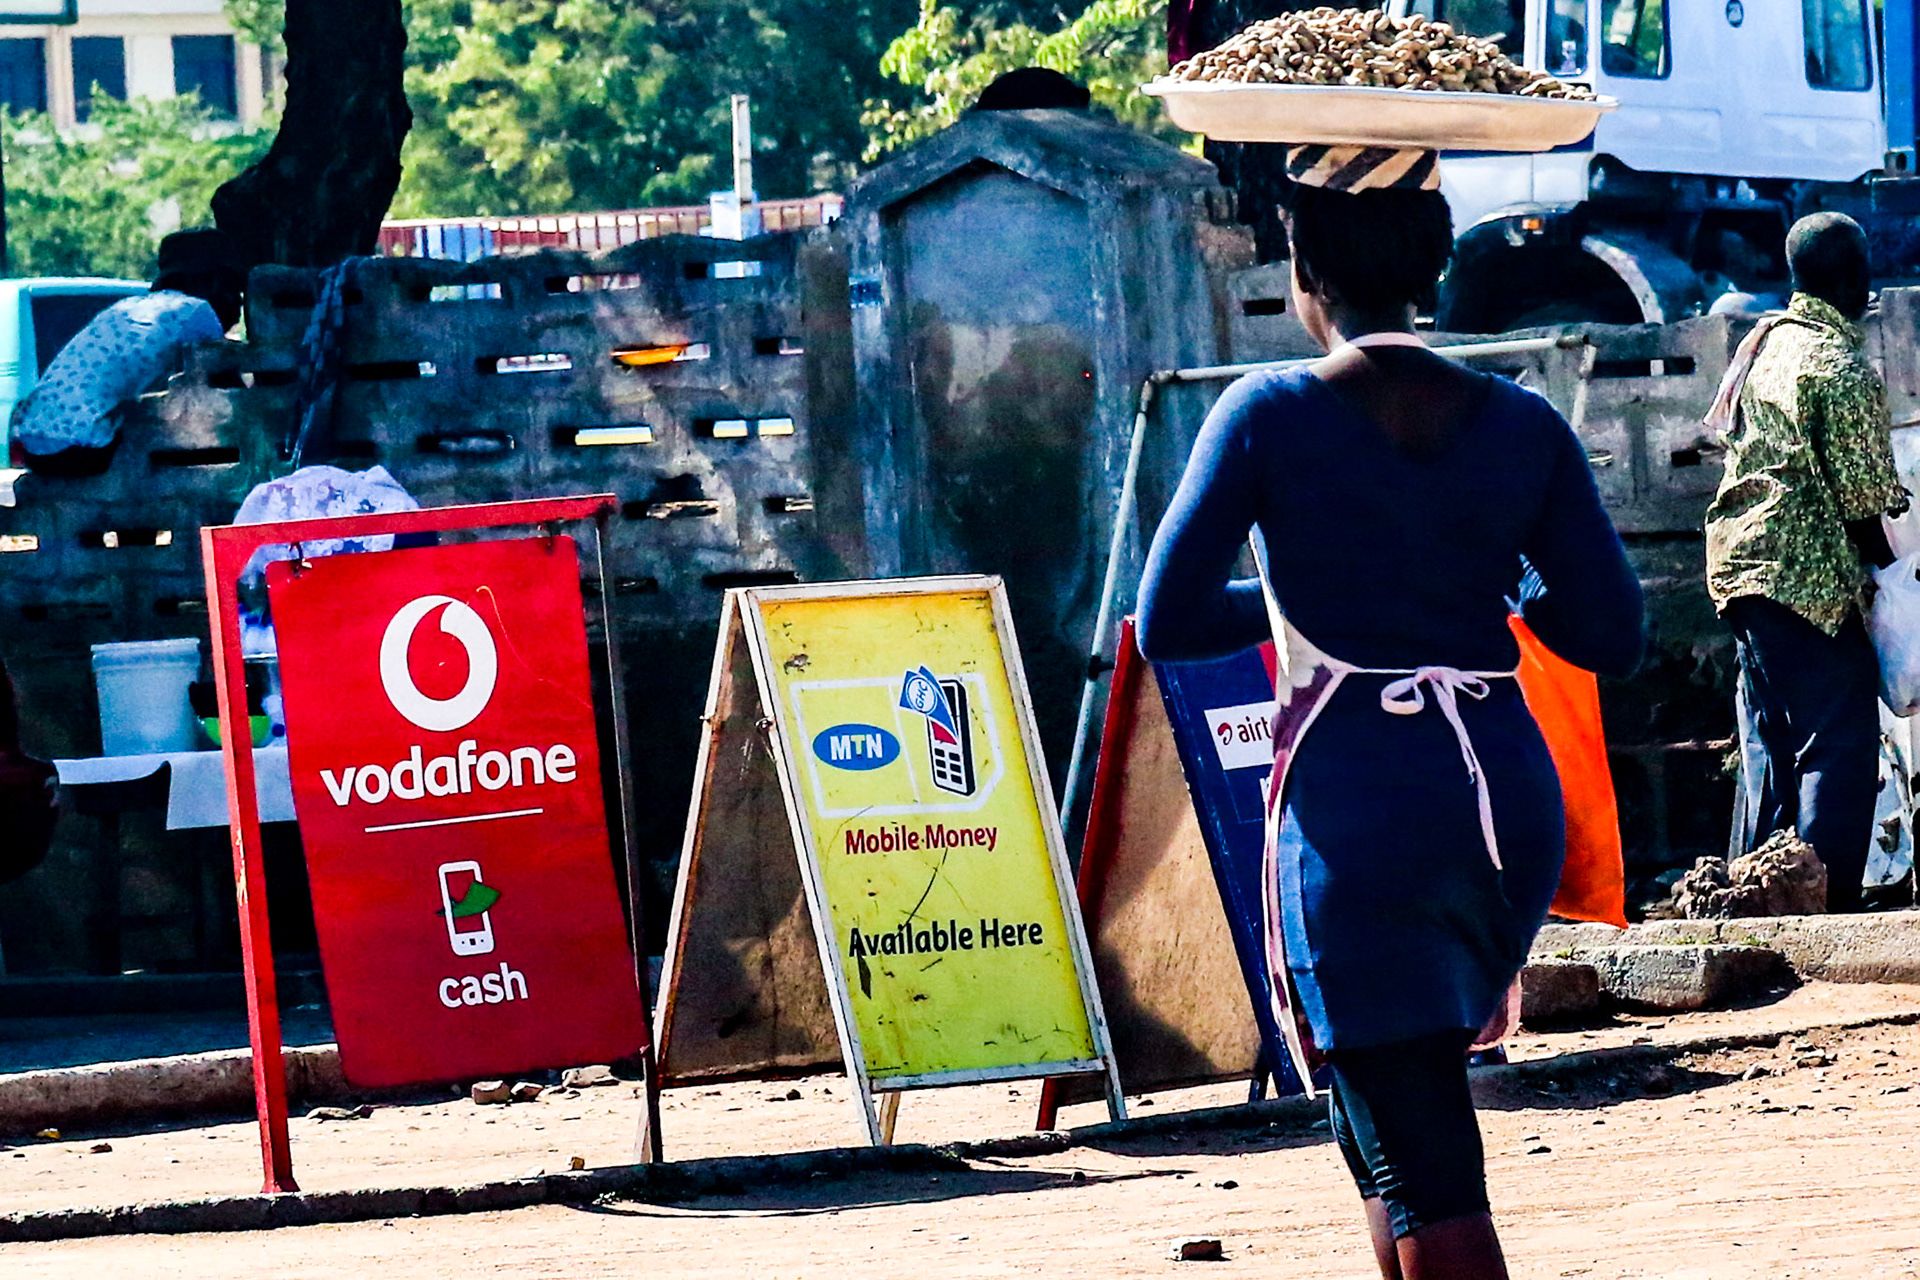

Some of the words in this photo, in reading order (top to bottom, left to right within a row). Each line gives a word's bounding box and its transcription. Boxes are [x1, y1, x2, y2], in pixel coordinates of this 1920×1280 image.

[915, 680, 928, 709] GHC
[1238, 715, 1273, 743] airt
[829, 733, 883, 761] MTN
[319, 739, 577, 806] vodafone
[845, 825, 920, 855] Mobile
[925, 824, 998, 852] Money
[849, 919, 974, 957] Available
[980, 918, 1044, 949] Here
[438, 961, 529, 1009] cash
